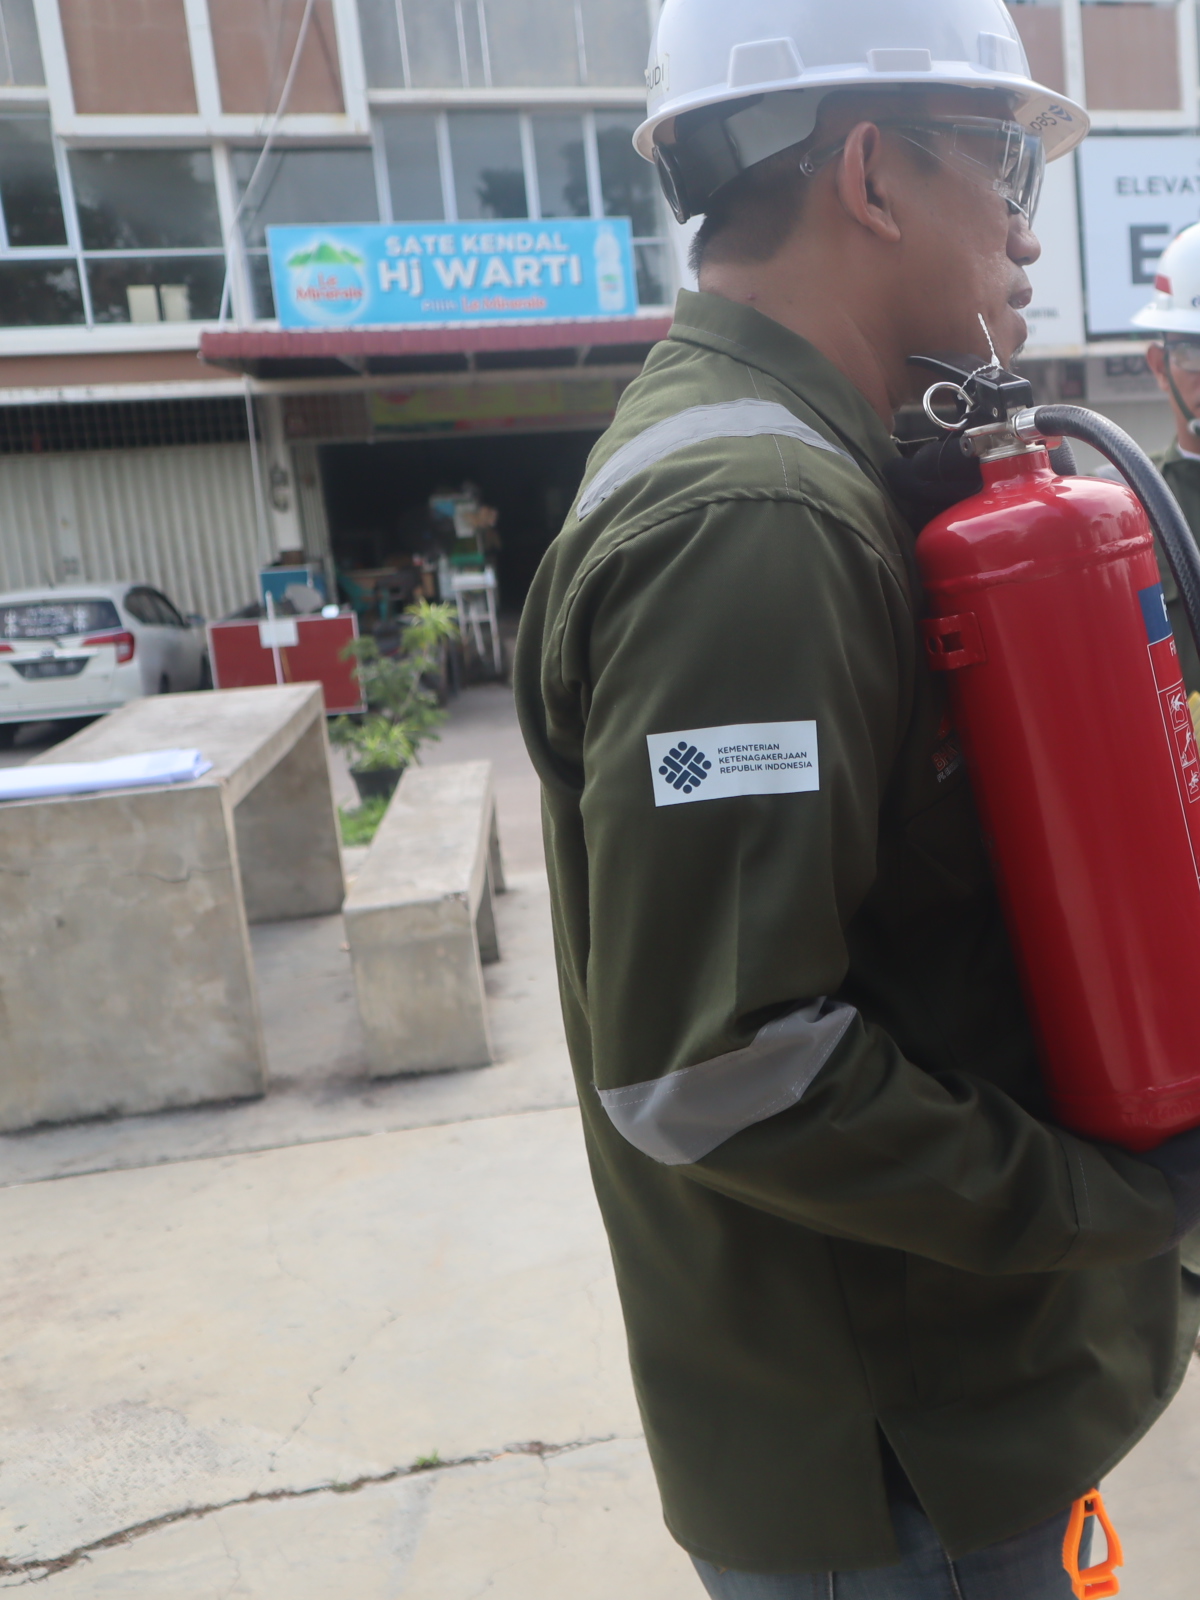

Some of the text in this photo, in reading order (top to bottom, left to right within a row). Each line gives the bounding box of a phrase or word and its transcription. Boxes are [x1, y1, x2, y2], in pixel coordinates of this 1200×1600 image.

[385, 231, 570, 257] SATE KENDAL
[378, 253, 583, 297] Hj WARTI
[718, 743, 780, 755] KEMENTERIAN
[718, 751, 808, 765] KETENAGAKERJAAN
[720, 761, 813, 774] REPUBLIK INDONESIA
